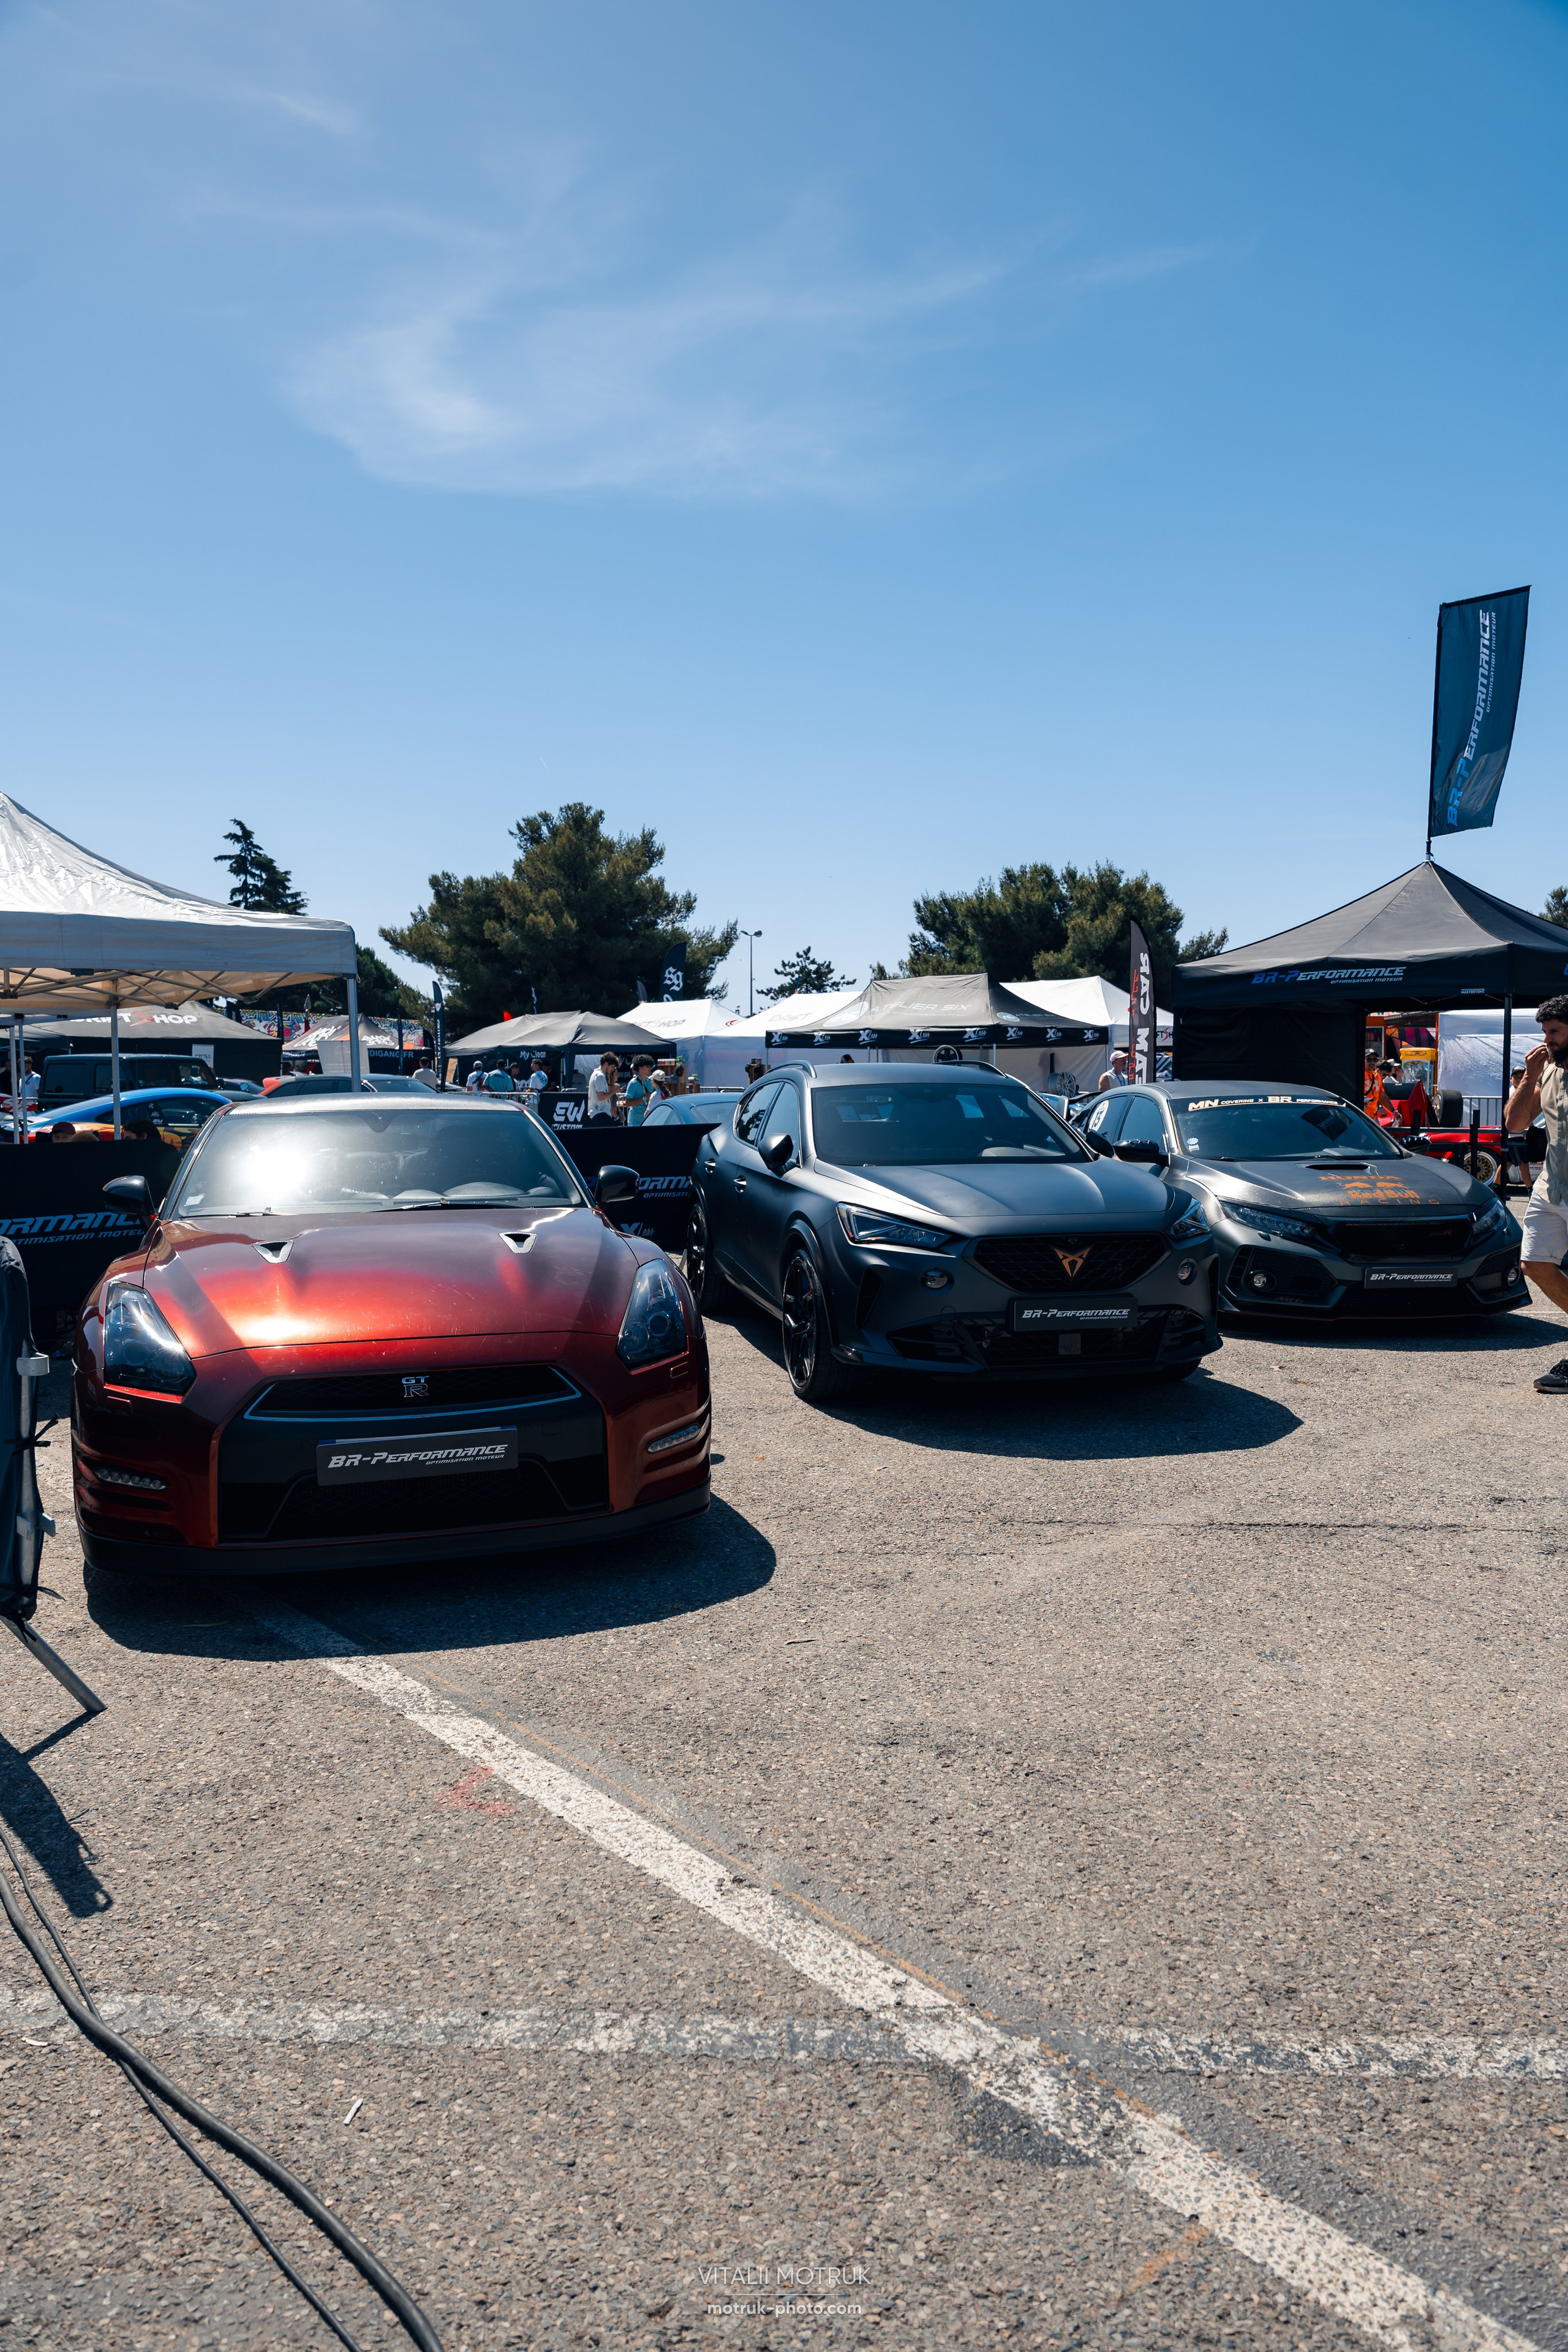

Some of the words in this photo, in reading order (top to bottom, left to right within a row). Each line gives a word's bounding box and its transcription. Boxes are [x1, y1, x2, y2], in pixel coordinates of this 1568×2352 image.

[1486, 653, 1496, 713] OPTIMISATION
[871, 1001, 938, 1012] ATELIER
[519, 1050, 529, 1060] My
[1188, 1099, 1219, 1111] MN
[1091, 1110, 1104, 1128] 13
[402, 1376, 429, 1384] GT
[404, 1384, 430, 1397] R
